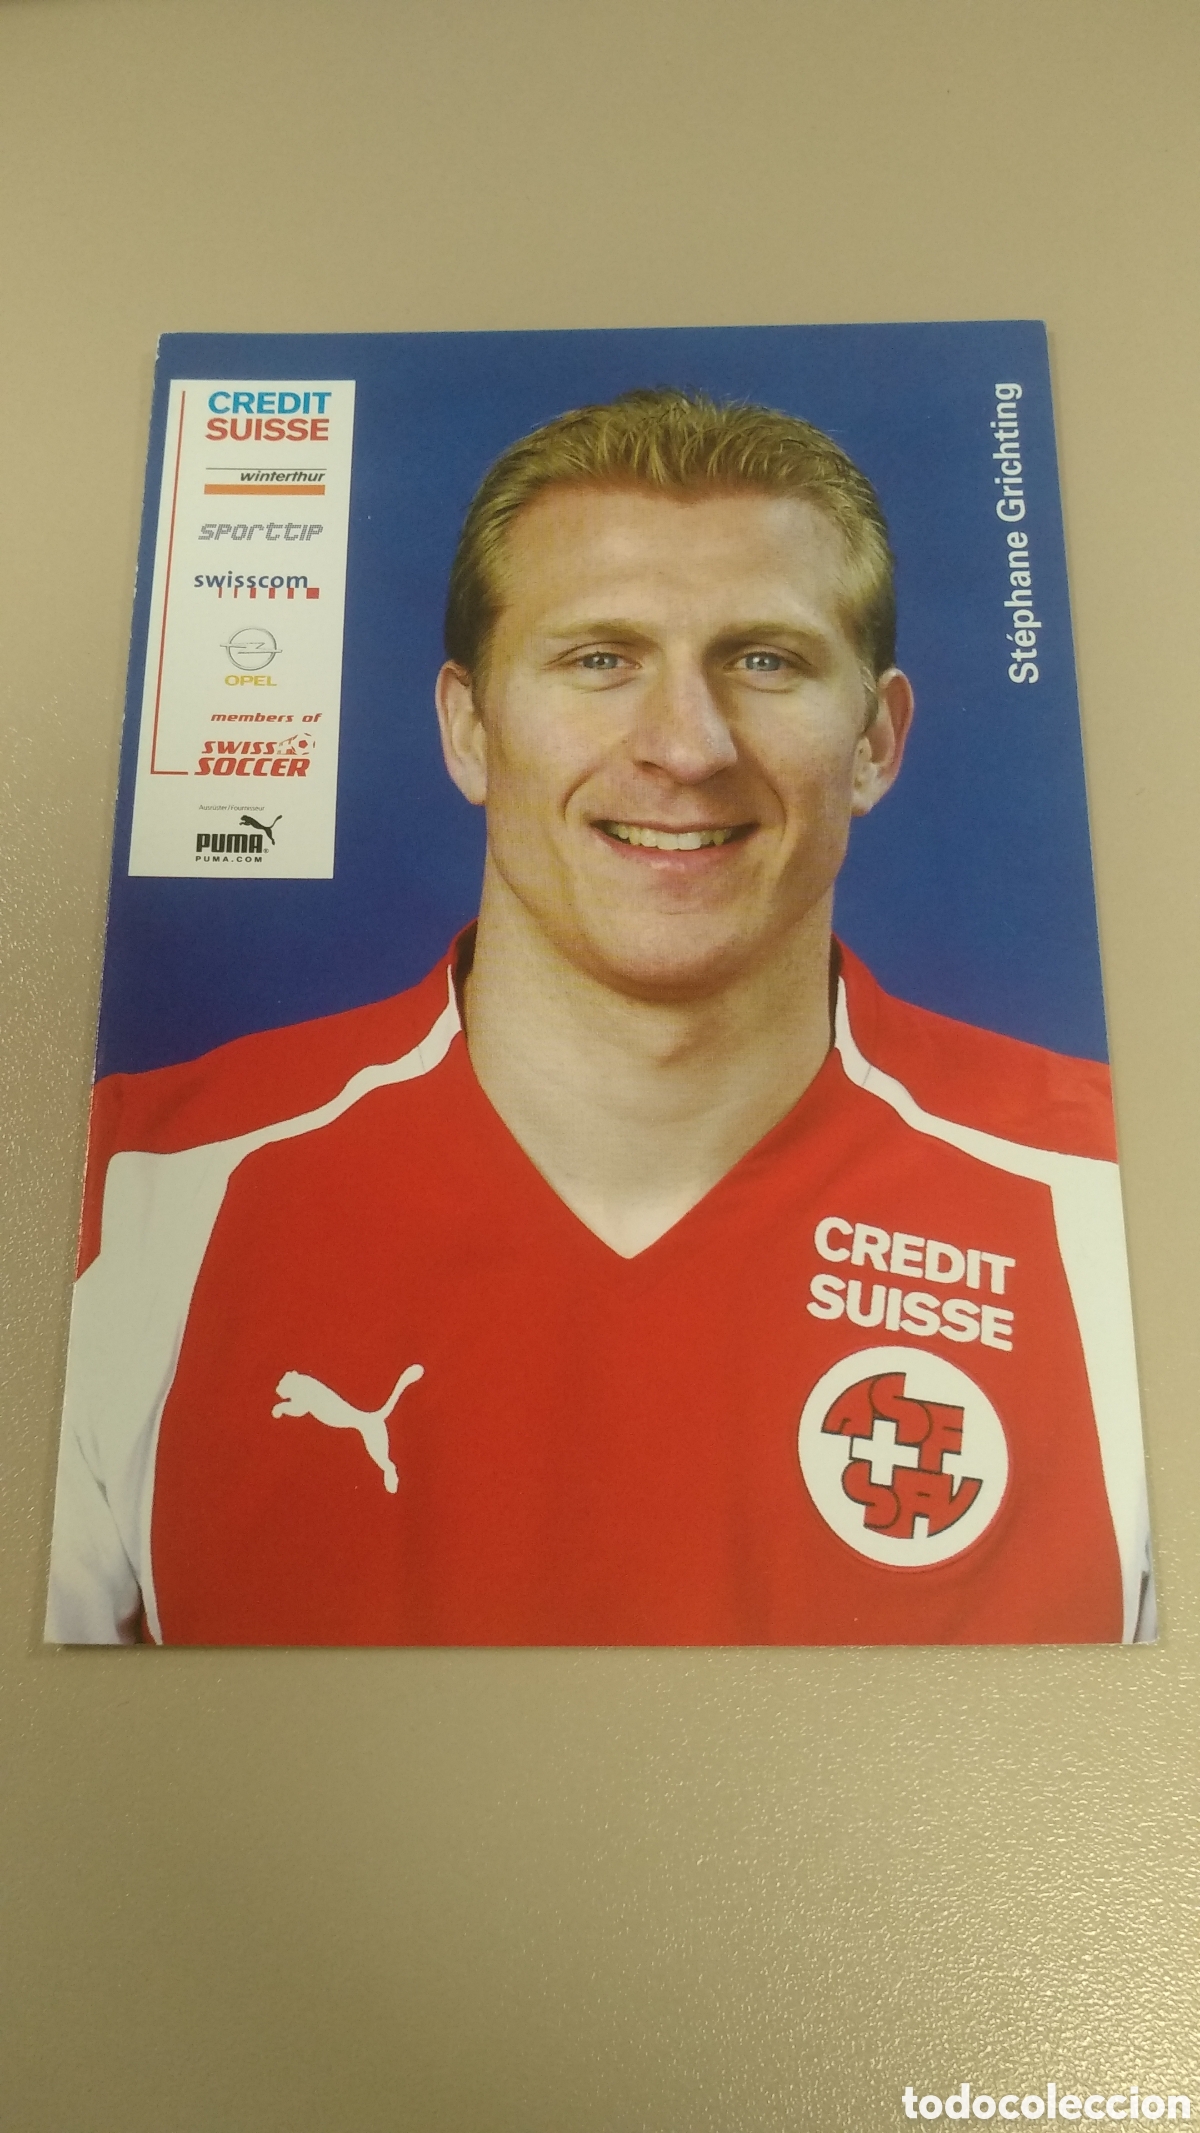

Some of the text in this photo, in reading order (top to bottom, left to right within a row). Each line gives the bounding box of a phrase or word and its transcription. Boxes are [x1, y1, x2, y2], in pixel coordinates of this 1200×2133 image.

[208, 391, 332, 415] CREDIT
[205, 417, 330, 441] SUISSE
[240, 470, 326, 482] winterthur
[990, 382, 1042, 684] Stéphane Grichting
[194, 571, 308, 588] swisscom
[224, 675, 278, 687] OPEL
[211, 712, 323, 723] members of
[201, 741, 278, 755] SWISS
[194, 757, 310, 777] SOCCER
[196, 833, 264, 854] PUMA
[195, 855, 263, 863] PUMA.COM
[814, 1216, 1016, 1295] CREDIT
[806, 1273, 1015, 1352] SUISSE
